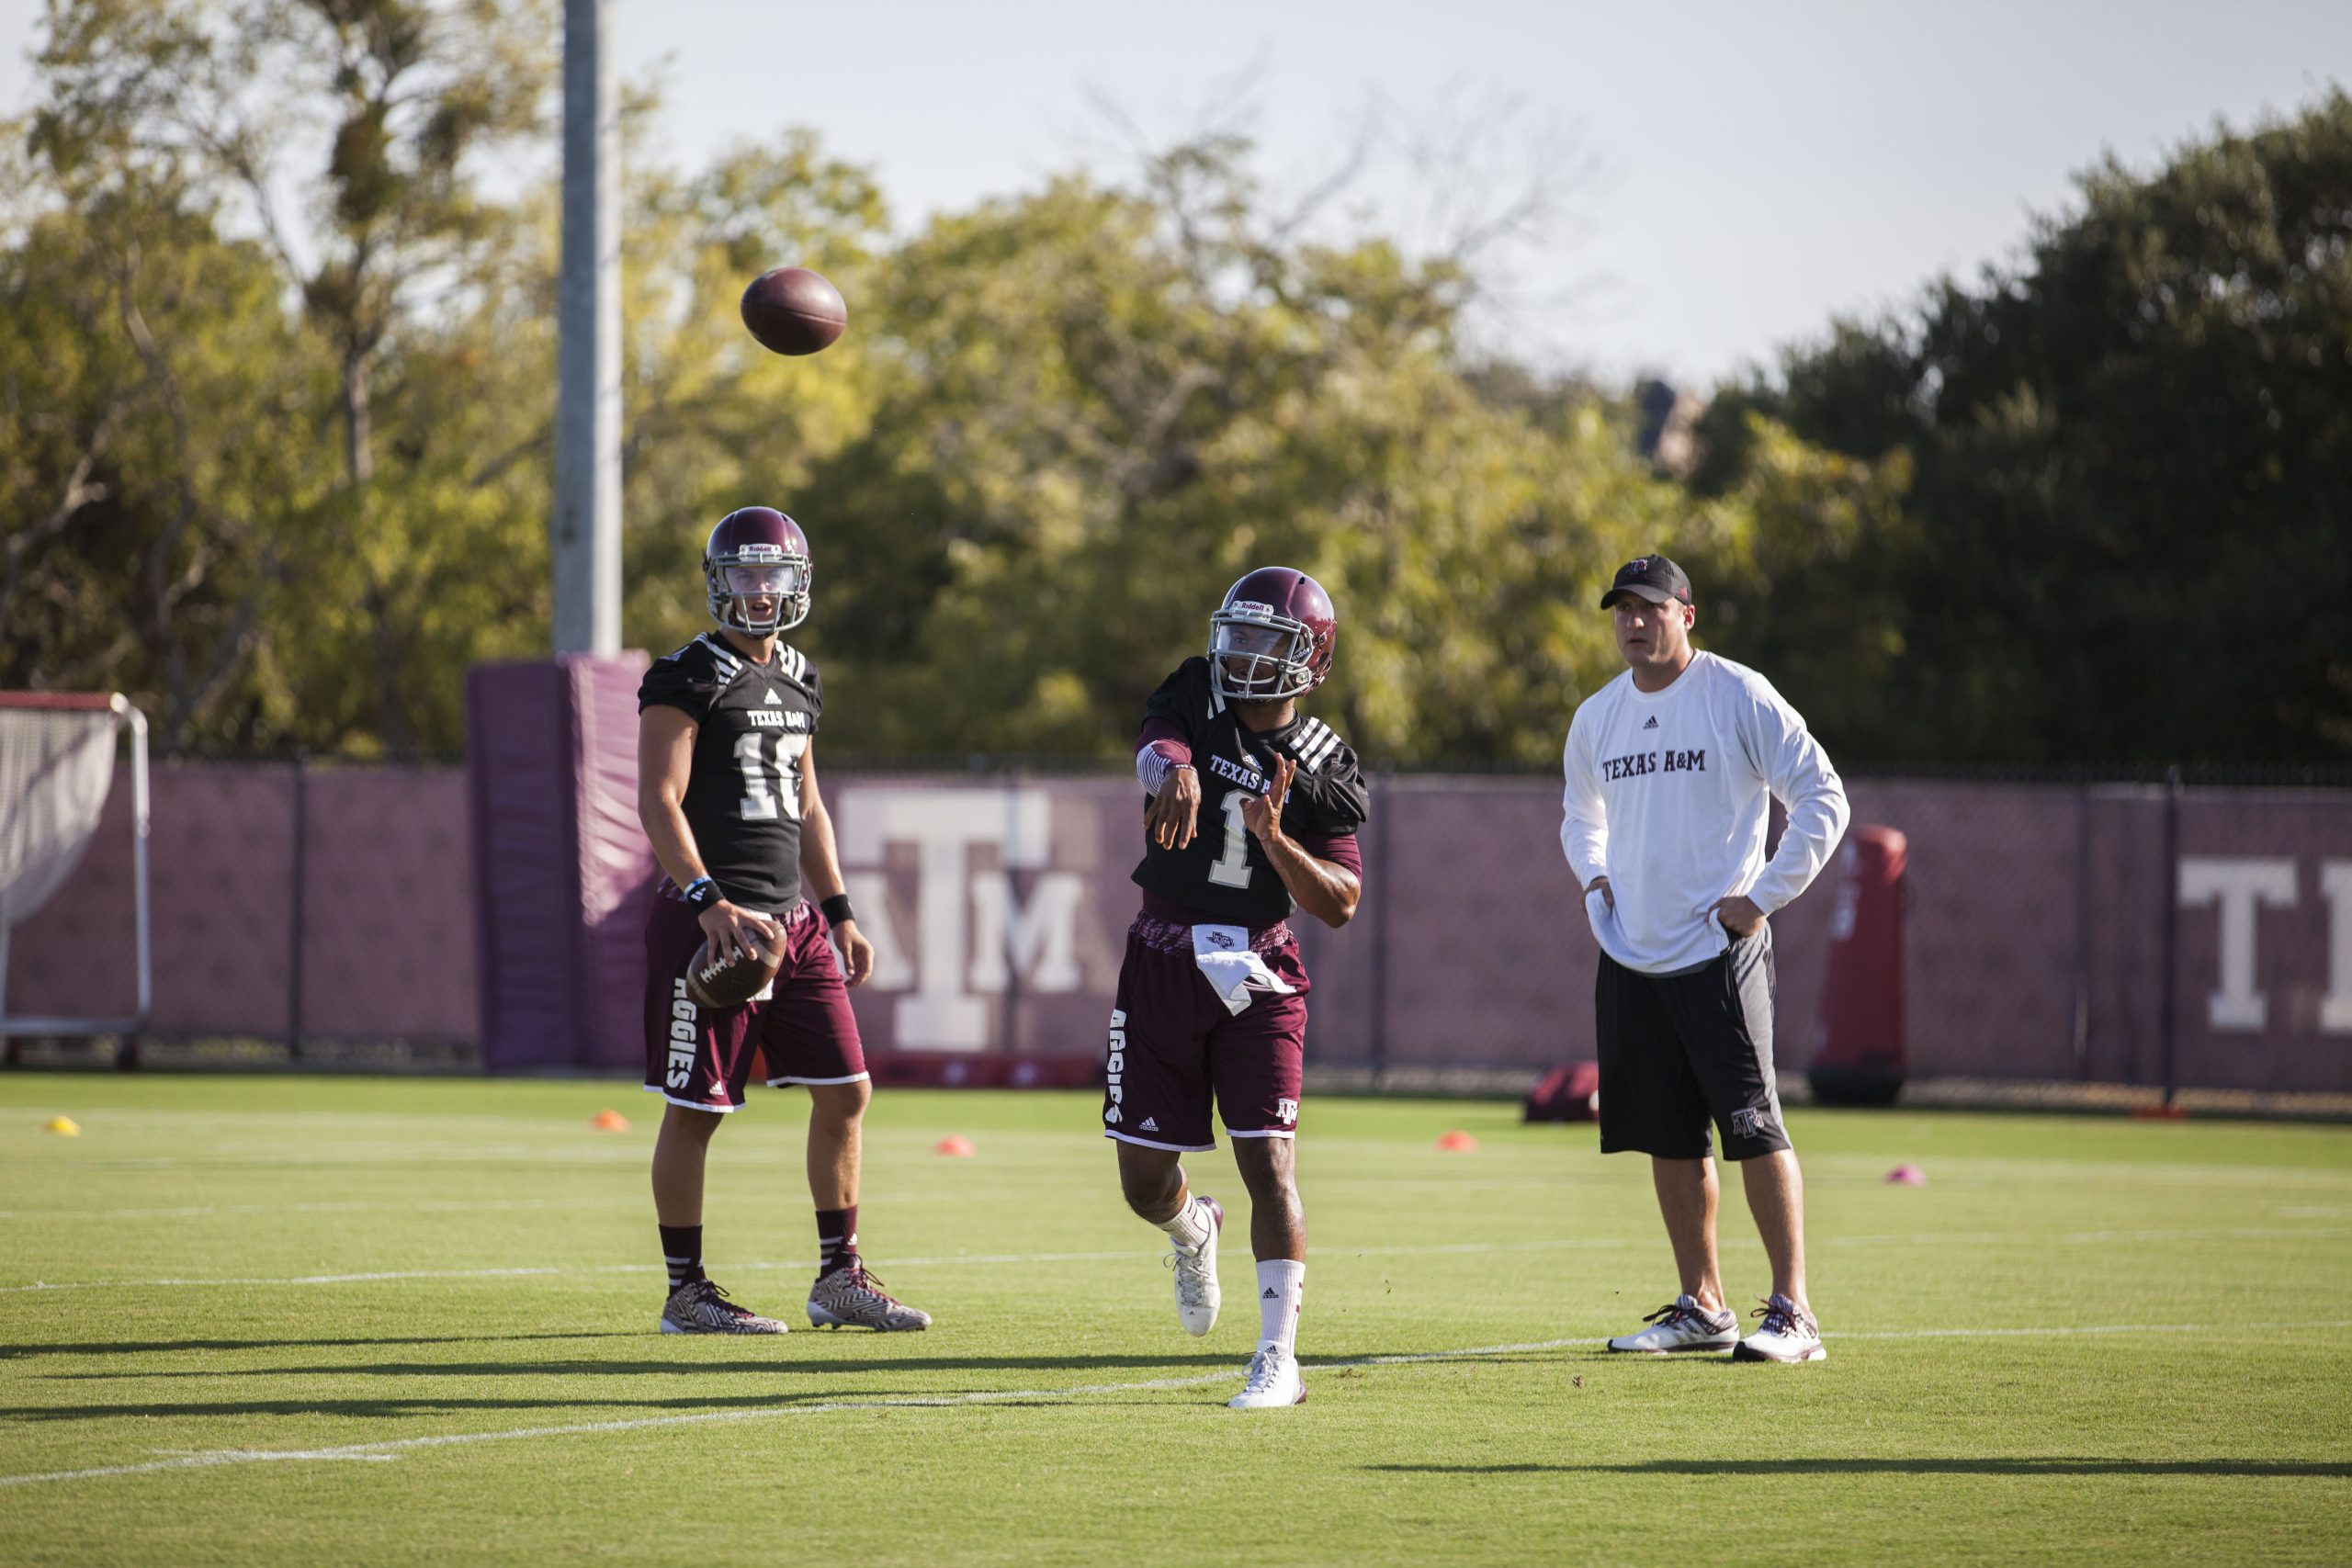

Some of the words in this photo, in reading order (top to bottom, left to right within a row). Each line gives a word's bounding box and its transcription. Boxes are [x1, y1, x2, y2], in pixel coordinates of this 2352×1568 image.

[1241, 602, 1265, 611] Riddell
[747, 710, 785, 727] TEXAS
[1209, 754, 1260, 790] TEXAS
[1602, 750, 1657, 783] TEXAS
[1664, 750, 1706, 772] A&M
[1207, 788, 1259, 889] 1
